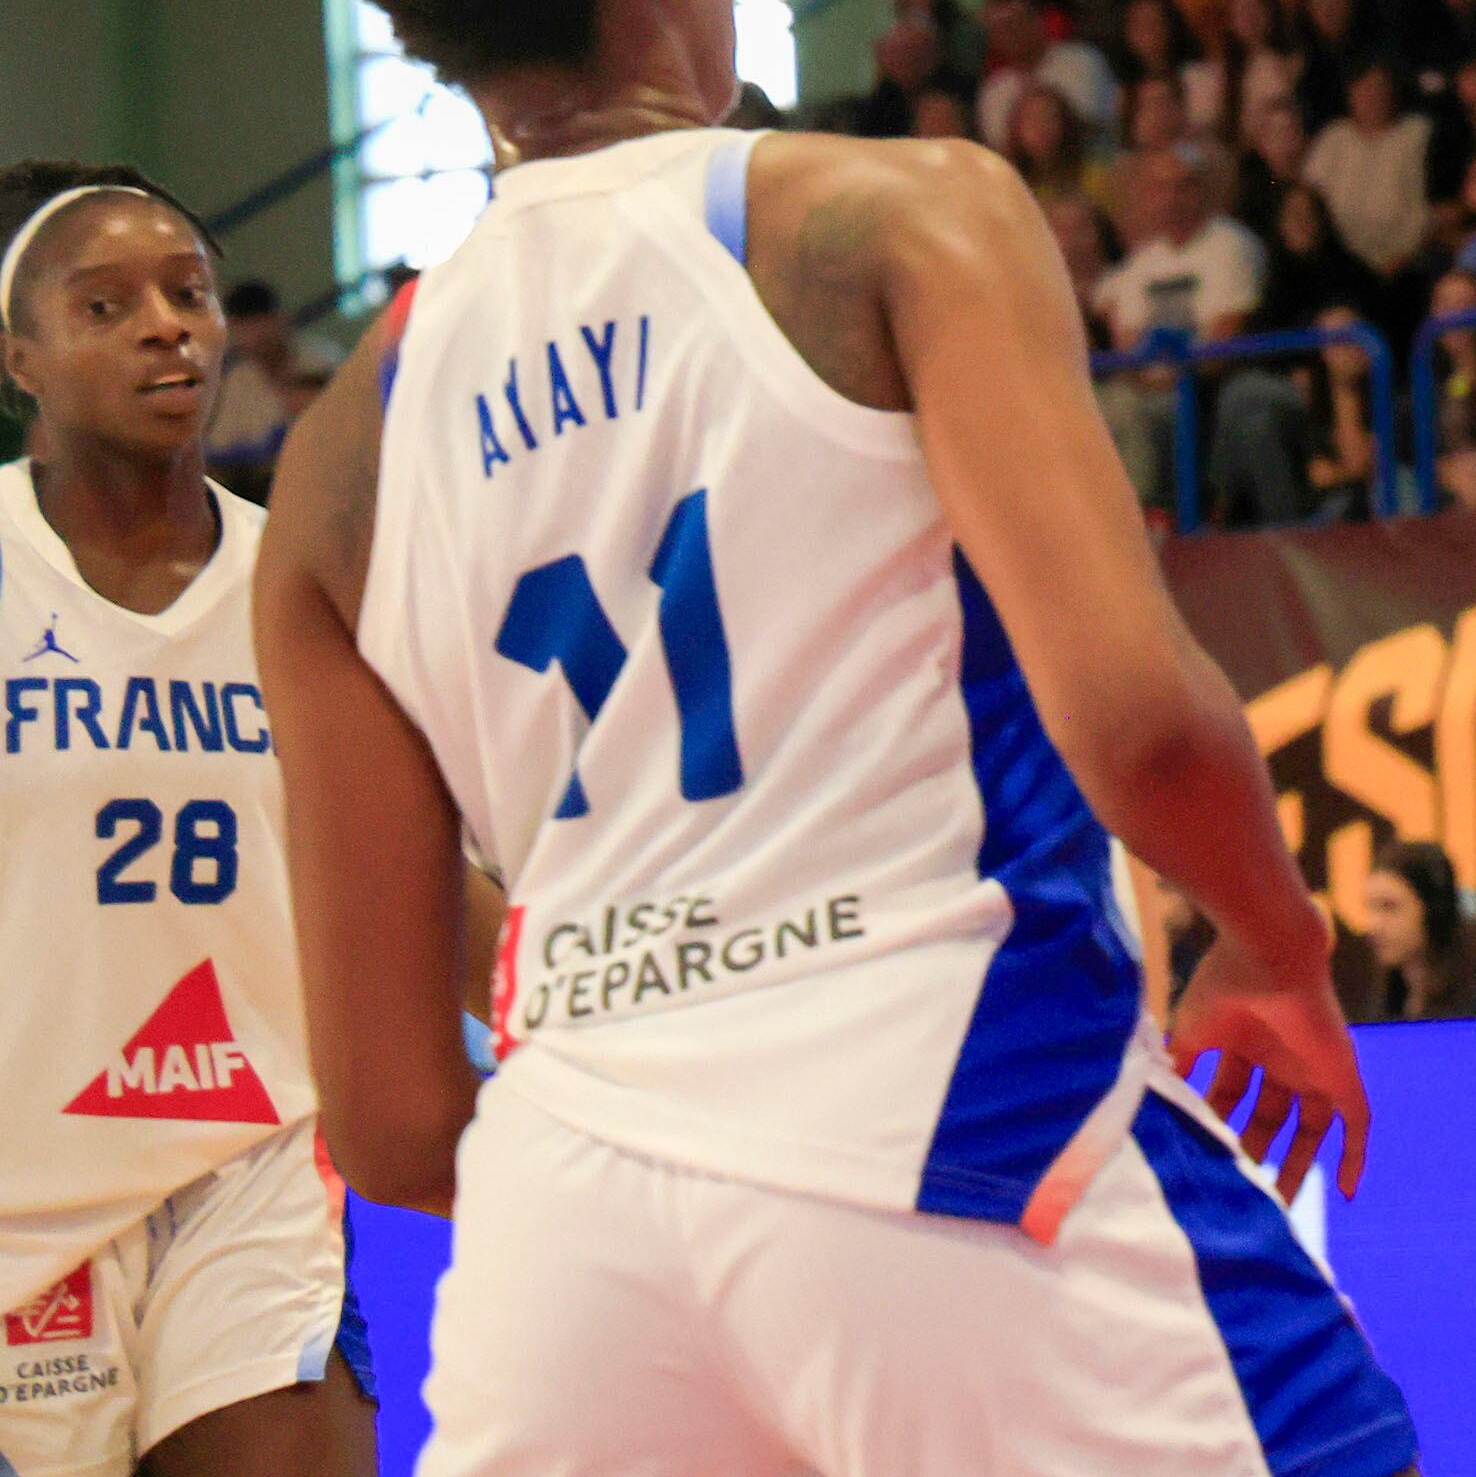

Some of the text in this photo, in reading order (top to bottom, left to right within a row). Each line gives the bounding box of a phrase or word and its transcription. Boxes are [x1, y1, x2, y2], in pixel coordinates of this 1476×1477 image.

[475, 315, 649, 479] AYAYI
[495, 488, 744, 820] 11
[5, 676, 279, 758] FRANC
[95, 798, 238, 905] 28
[524, 895, 865, 1029] D'EPARGNE
[543, 895, 720, 968] CAISSE
[107, 1042, 246, 1098] MAIF
[17, 1355, 91, 1379] CAISSE
